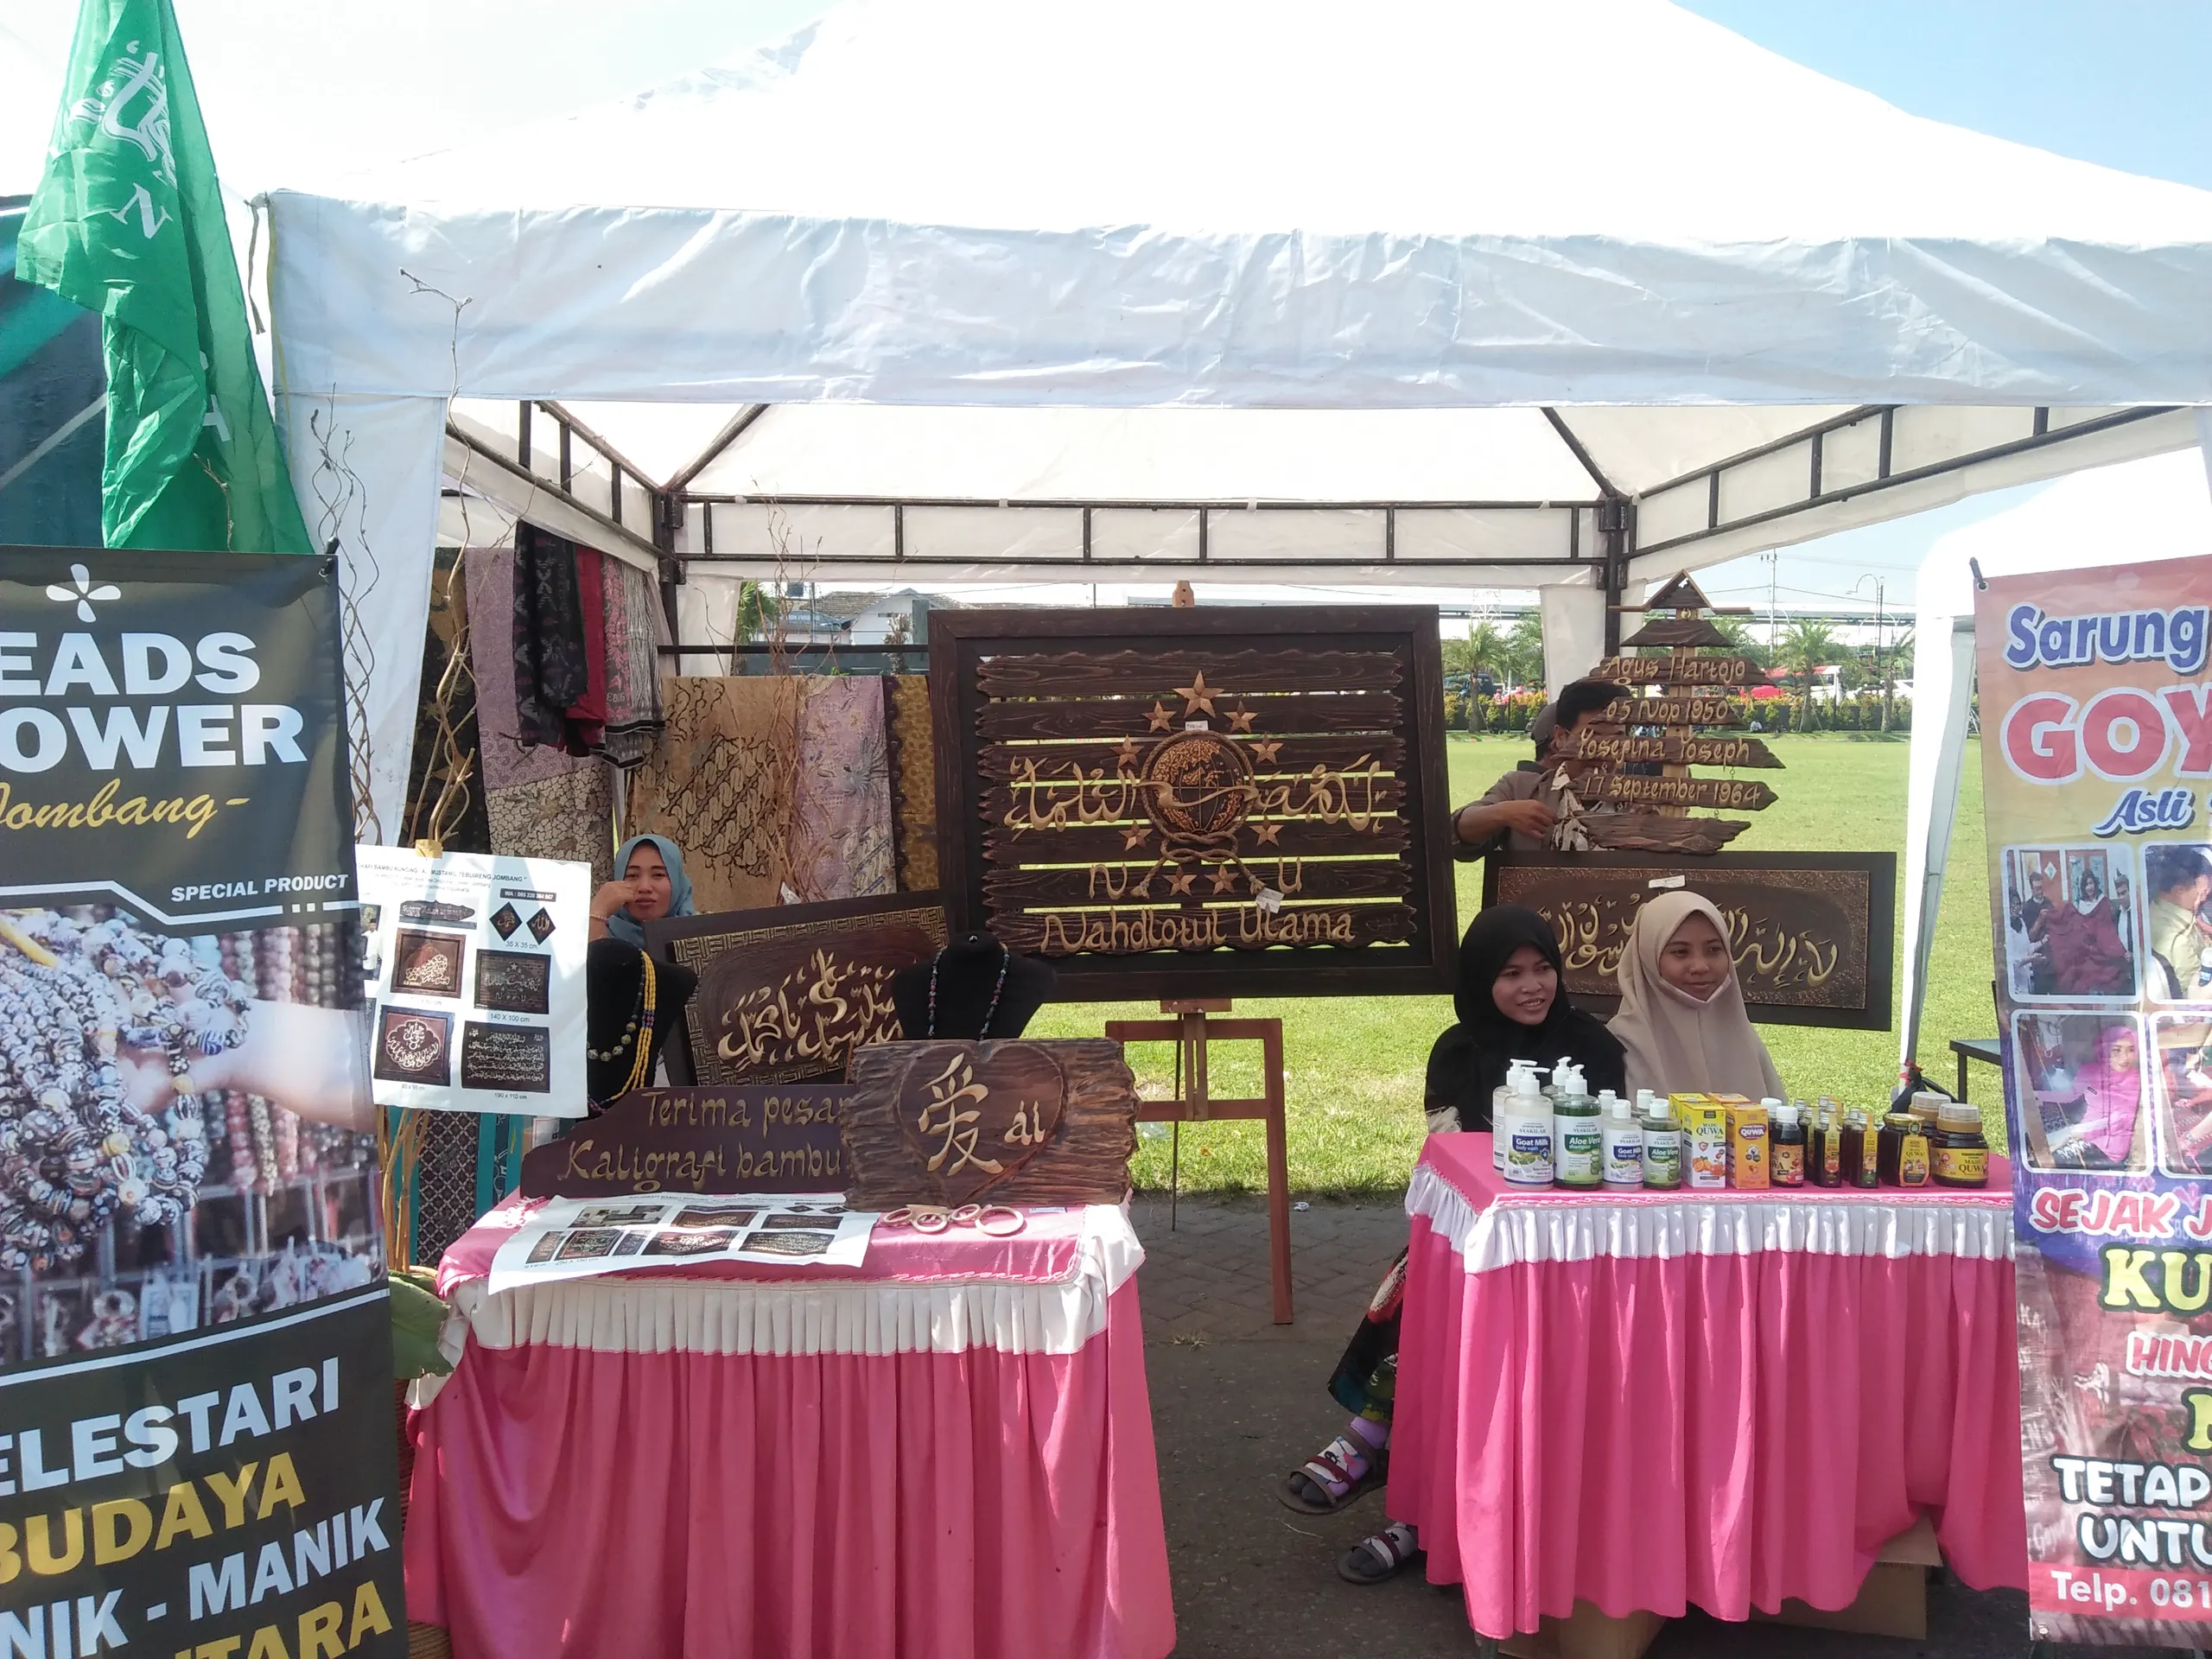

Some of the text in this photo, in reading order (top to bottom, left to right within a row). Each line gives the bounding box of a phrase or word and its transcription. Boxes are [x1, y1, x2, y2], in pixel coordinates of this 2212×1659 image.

[2003, 604, 2209, 673] Sarung
[1602, 655, 1746, 685] Agus Hartojo
[1606, 701, 1633, 723] 05
[1685, 701, 1729, 722] 1950
[1680, 731, 1751, 772] Yoseph
[1584, 775, 1761, 809] 17 September 1964
[2093, 788, 2192, 835] Asli
[171, 874, 348, 902] SPECIAL PRODUCT
[641, 1090, 751, 1127] Terima
[918, 1052, 1004, 1176] 爱
[1696, 1127, 1724, 1135] QUWA
[557, 1139, 840, 1192] Kaligrafi bambu
[2029, 1187, 2180, 1238] SEJAK
[2052, 1457, 2211, 1509] TETAP
[188, 1497, 391, 1621] MANIK
[2050, 1570, 2138, 1611] Telp.
